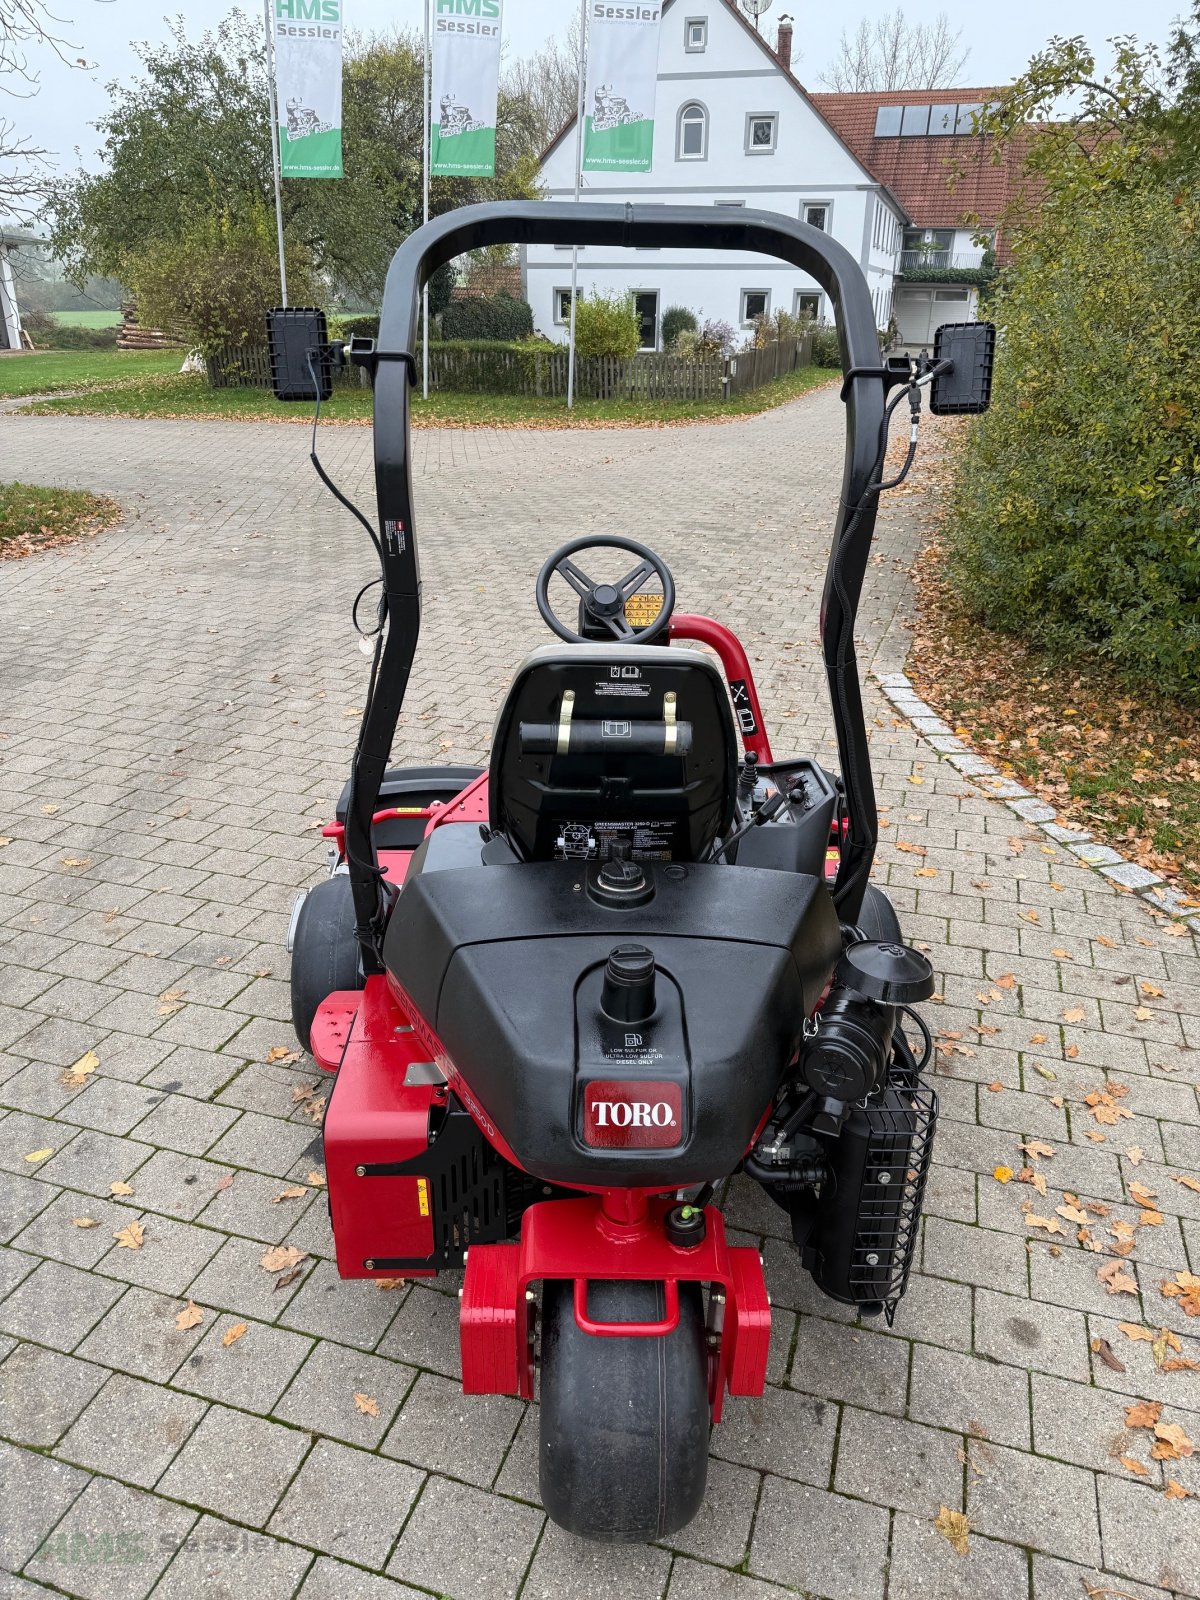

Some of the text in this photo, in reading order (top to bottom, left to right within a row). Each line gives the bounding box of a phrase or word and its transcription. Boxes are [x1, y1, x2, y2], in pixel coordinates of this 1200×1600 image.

[275, 0, 339, 22] HMS
[593, 4, 660, 21] Sessler
[276, 23, 340, 39] Sessler
[436, 18, 499, 36] Sessler
[433, 162, 493, 170] www.hms-sessler.de
[585, 157, 650, 165] www.hms-sessler.de
[591, 1101, 673, 1127] TORO
